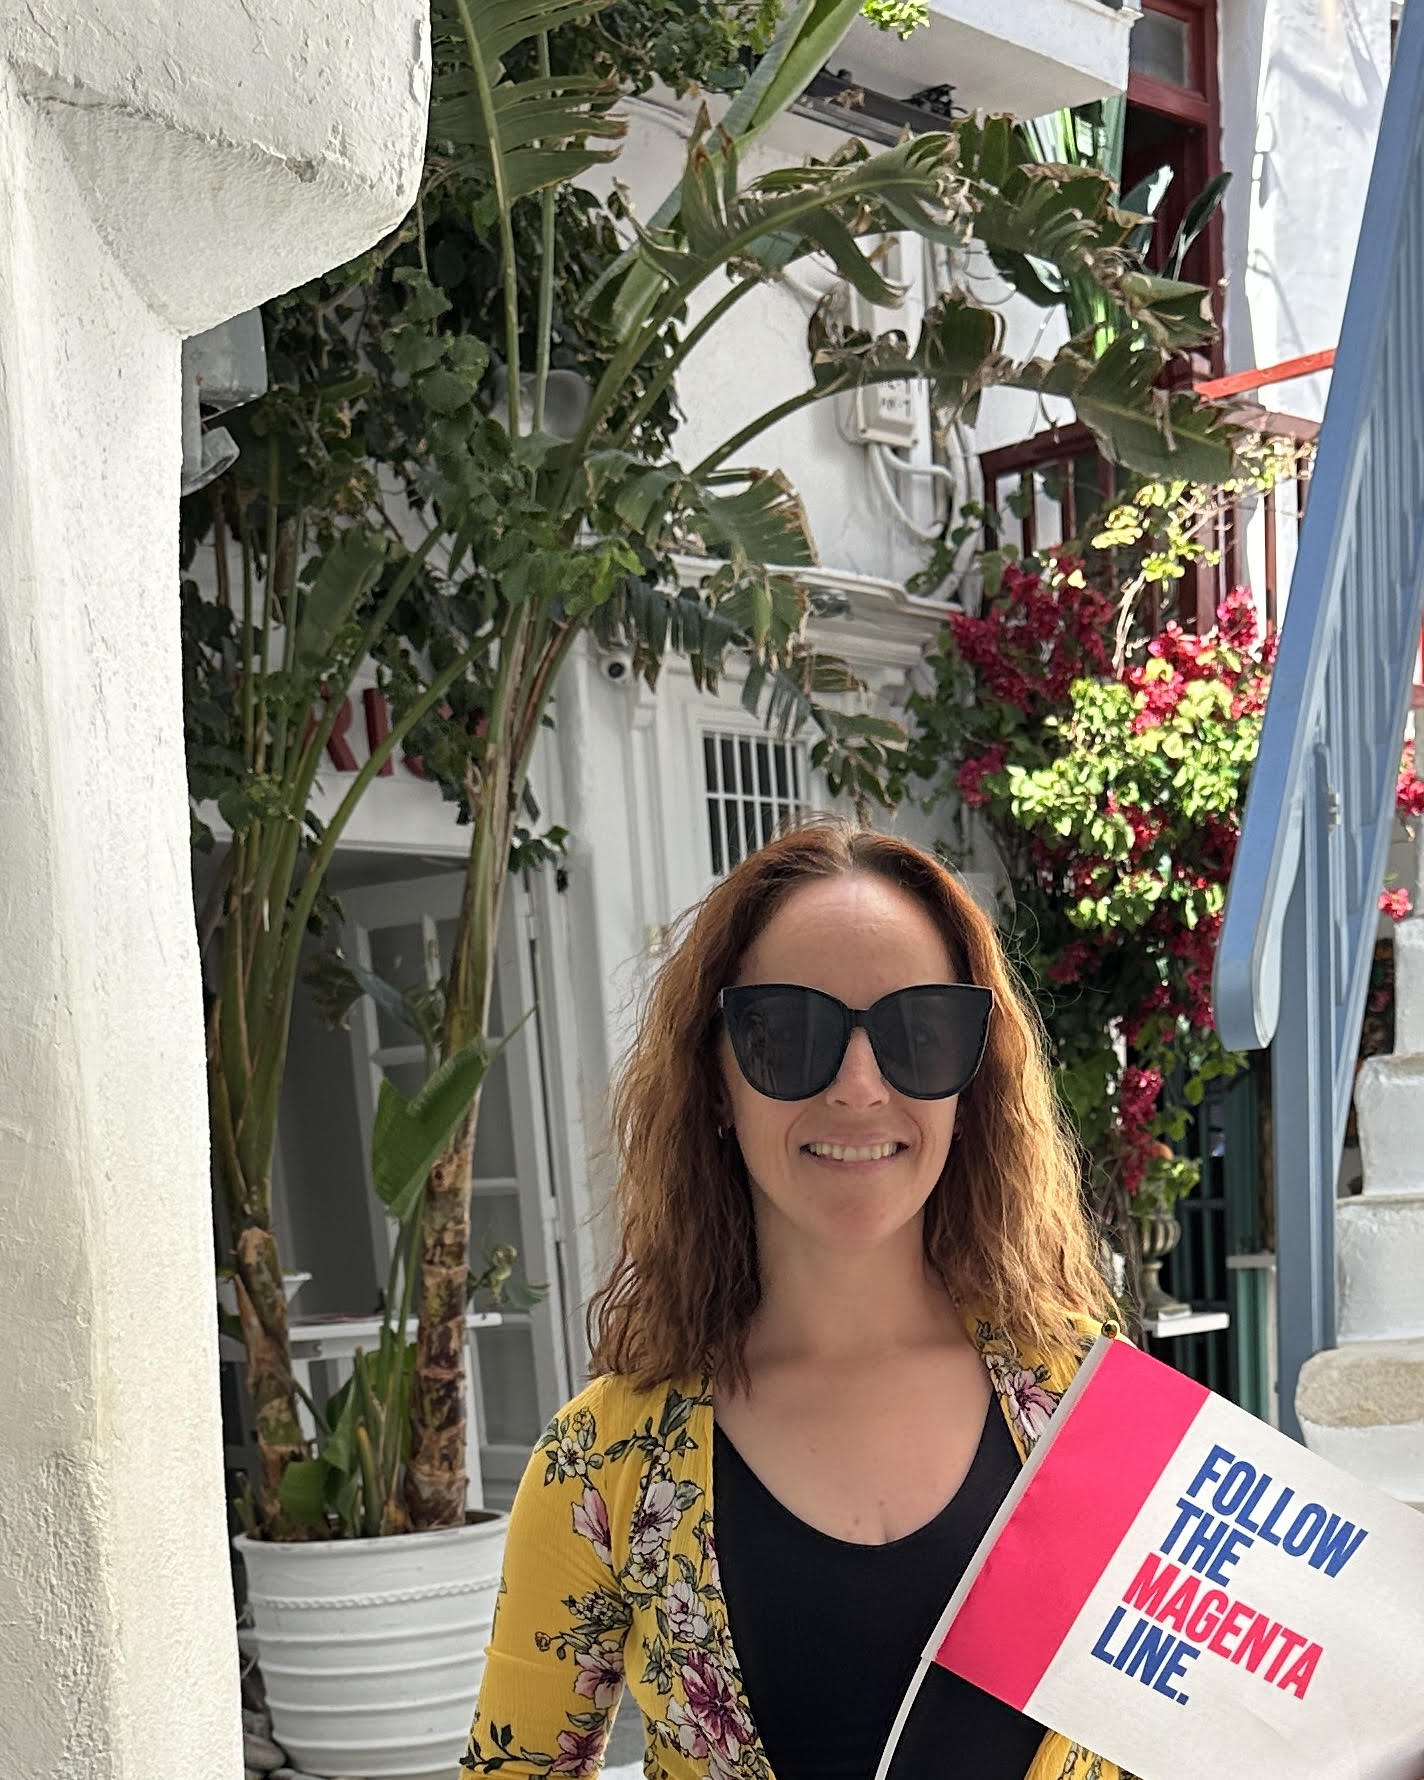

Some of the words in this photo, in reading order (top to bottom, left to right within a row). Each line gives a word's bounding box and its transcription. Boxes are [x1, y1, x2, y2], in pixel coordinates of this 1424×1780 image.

[1160, 1497, 1254, 1587] THE
[1186, 1444, 1368, 1578] FOLLOW
[1091, 1606, 1201, 1705] LINE.
[1121, 1552, 1324, 1701] MAGENTA
